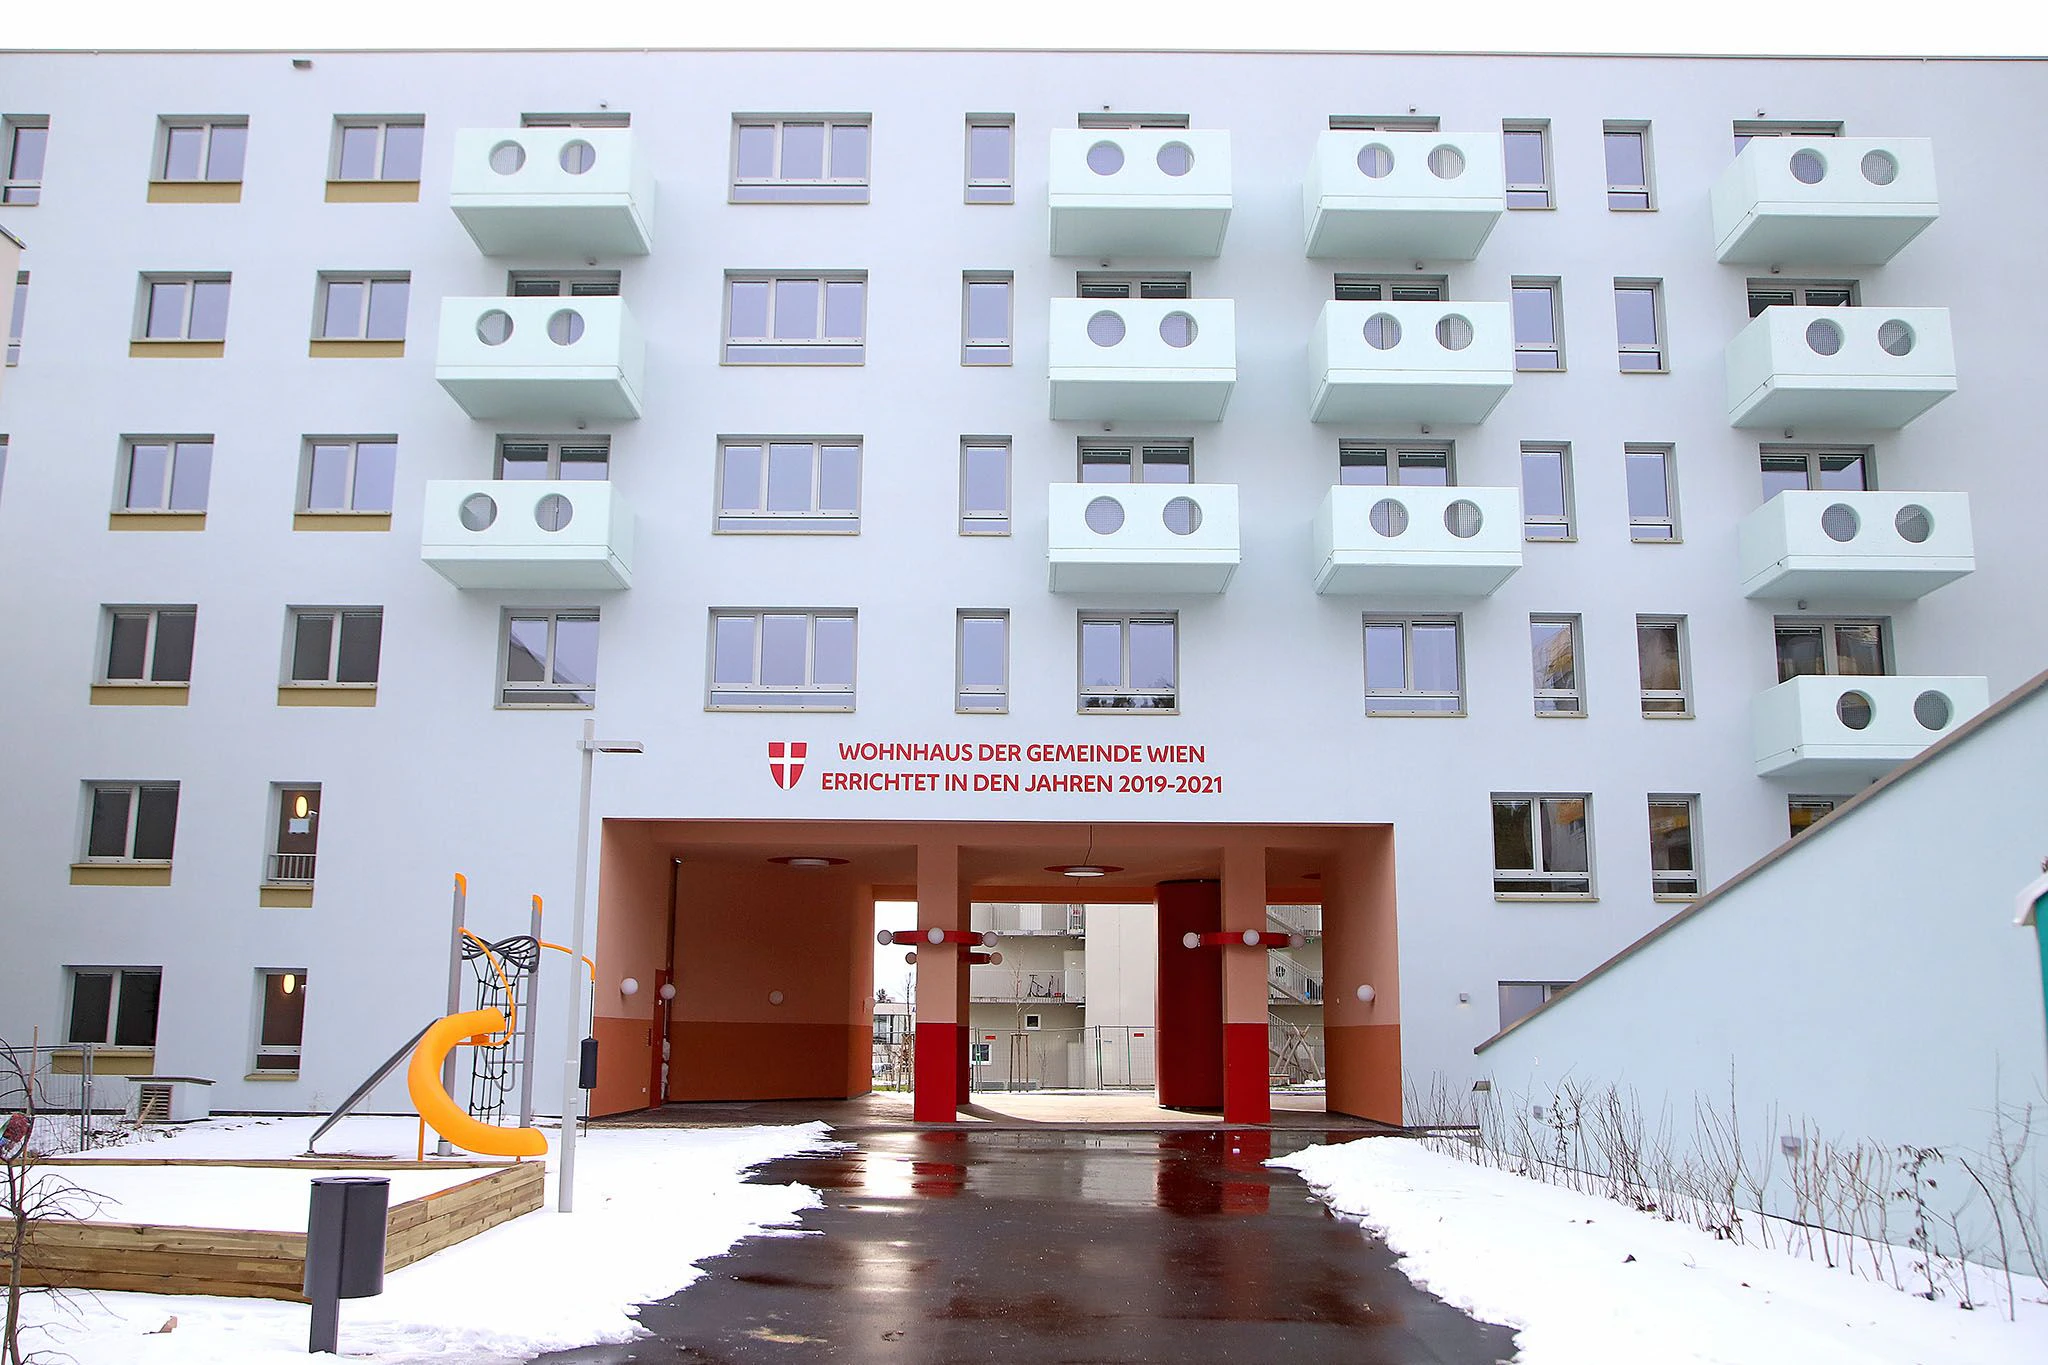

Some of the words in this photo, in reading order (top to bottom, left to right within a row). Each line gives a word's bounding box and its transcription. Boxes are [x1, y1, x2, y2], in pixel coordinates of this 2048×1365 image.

[840, 743, 974, 762] WOHNHAUS
[979, 743, 1022, 762] DER
[1027, 744, 1142, 763] GEMEINDE
[1147, 744, 1206, 763] WIEN
[822, 772, 941, 792] ERRICHTET
[945, 773, 968, 792] IN
[974, 774, 1020, 792] DEN
[1024, 774, 1113, 793] JAHREN
[1119, 775, 1222, 794] 2019-2021
